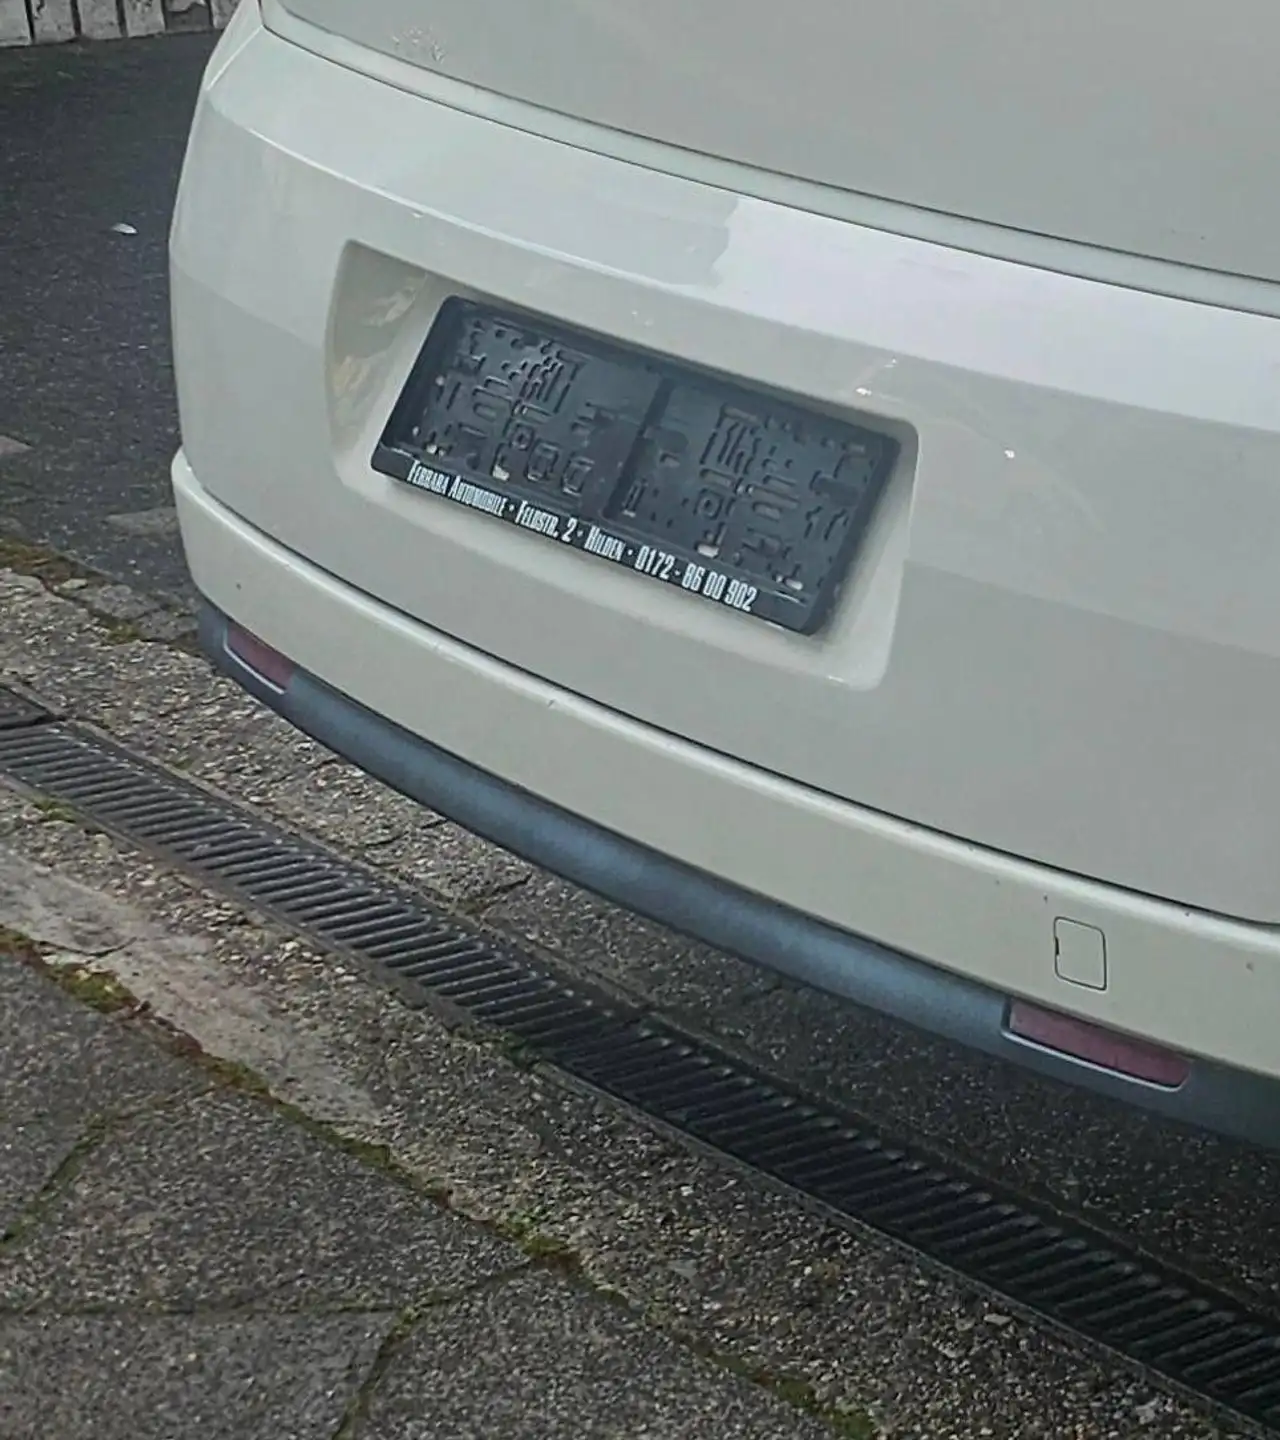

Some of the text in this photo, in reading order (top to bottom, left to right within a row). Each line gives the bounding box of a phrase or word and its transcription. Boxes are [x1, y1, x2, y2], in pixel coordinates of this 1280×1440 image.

[561, 517, 578, 542] 2
[634, 545, 675, 580] 0172
[703, 572, 727, 600] 00
[725, 580, 757, 612] 902
